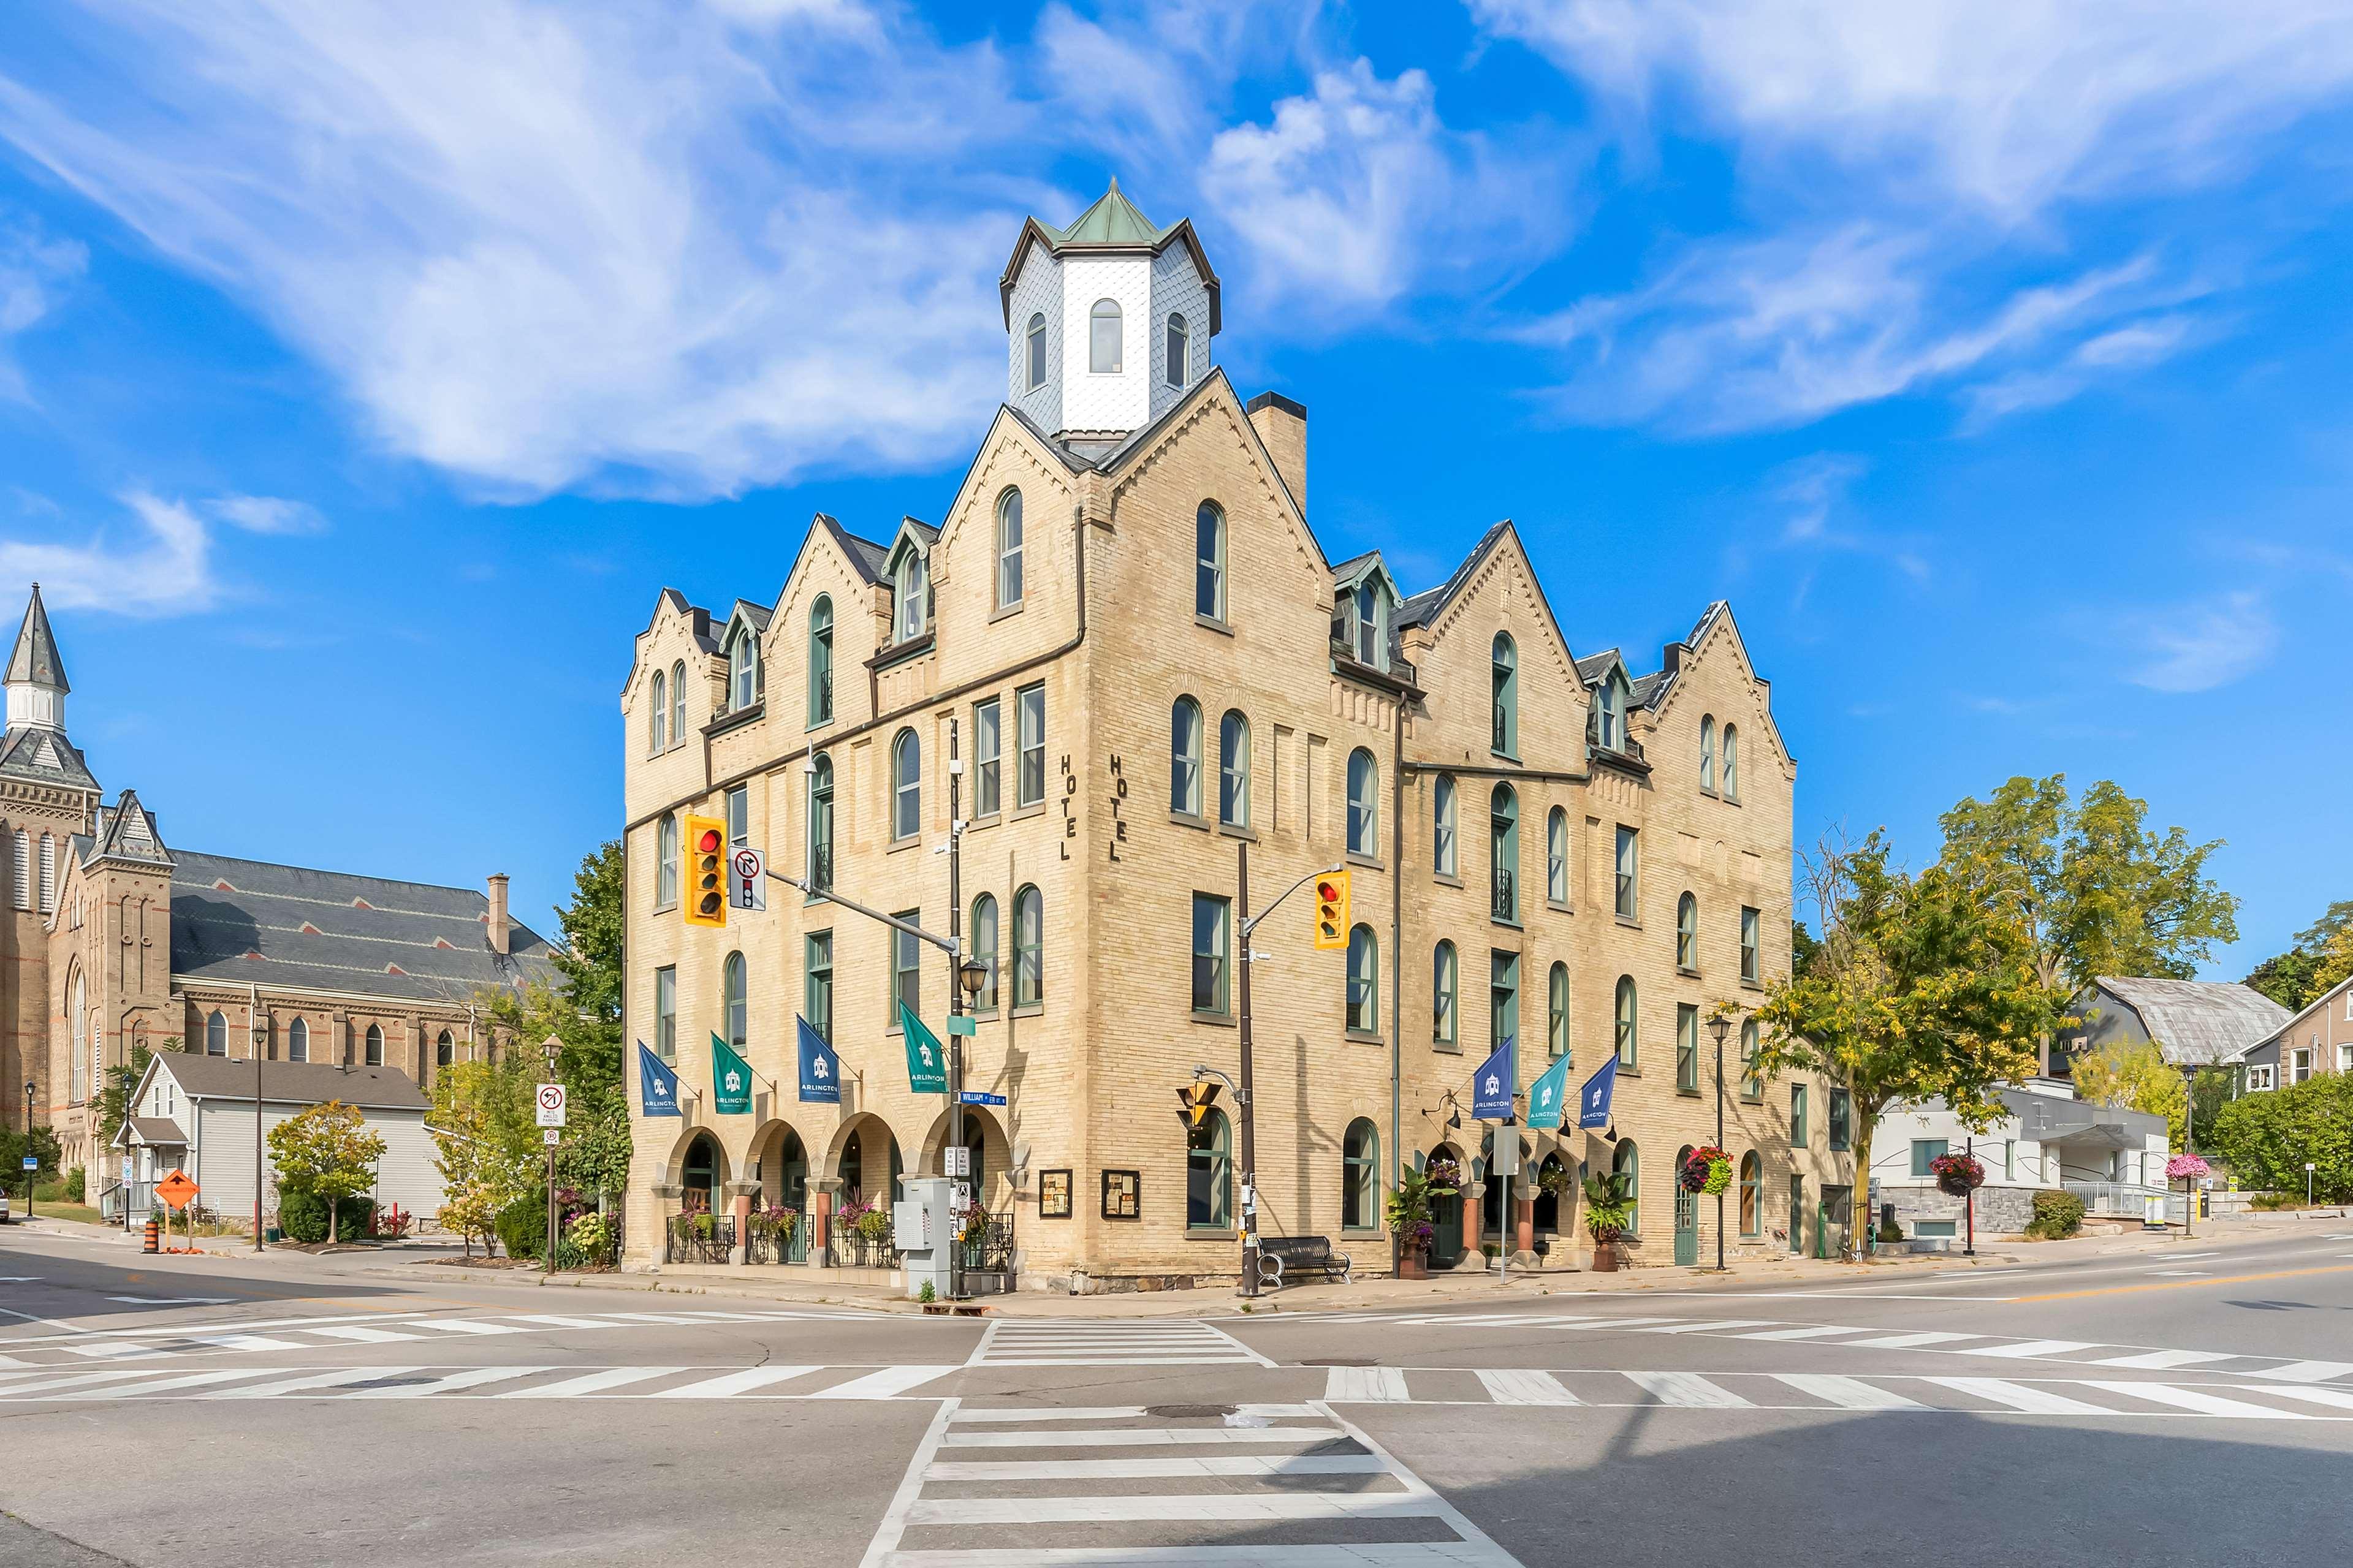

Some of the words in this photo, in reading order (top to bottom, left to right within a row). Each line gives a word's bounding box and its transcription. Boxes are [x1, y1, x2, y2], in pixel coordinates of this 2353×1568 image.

[1060, 754, 1076, 862] HOTEL
[1110, 754, 1128, 863] HOTEL
[962, 1093, 984, 1101] WILLIAM
